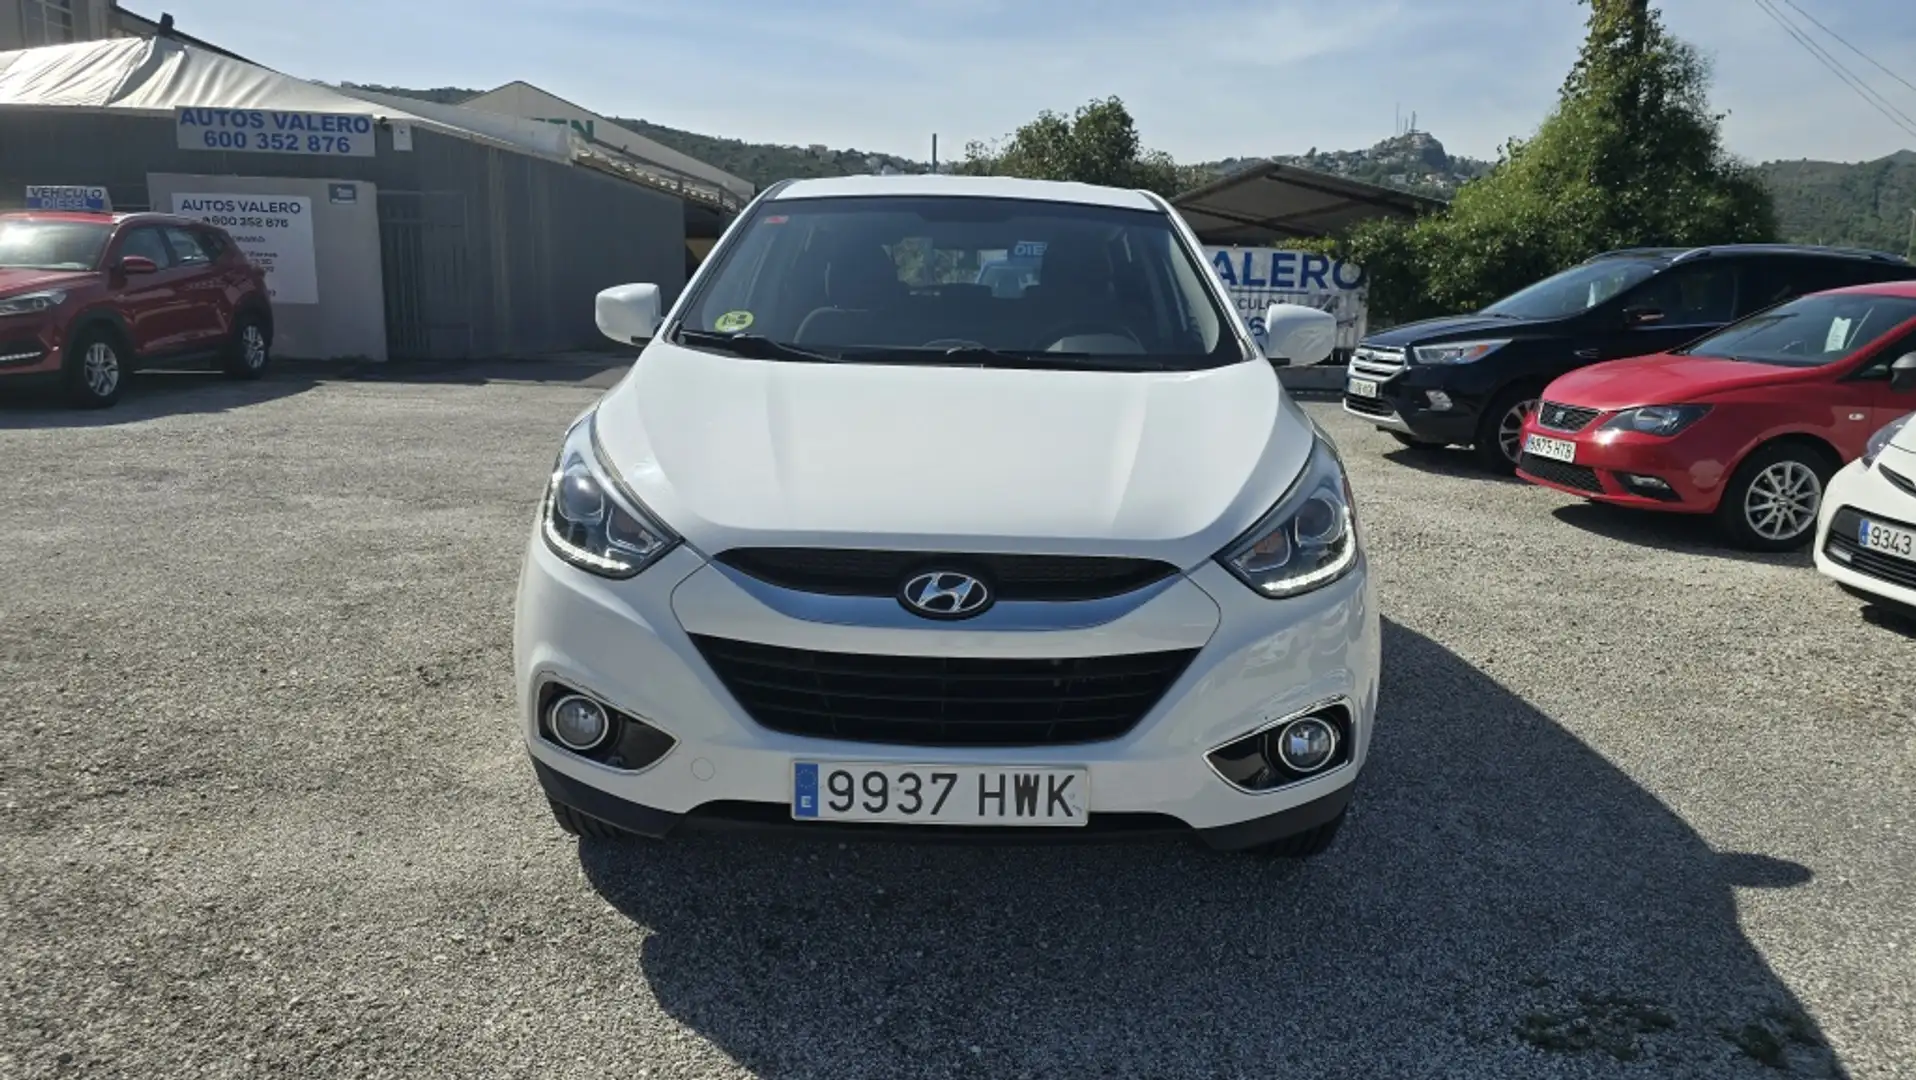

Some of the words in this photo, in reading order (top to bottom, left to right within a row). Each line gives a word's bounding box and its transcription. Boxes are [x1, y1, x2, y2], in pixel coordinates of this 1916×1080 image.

[180, 109, 265, 128] AUTOS
[273, 113, 370, 134] VALERO
[204, 130, 247, 148] 600
[256, 132, 299, 151] 352
[307, 135, 351, 153] 876
[41, 198, 87, 209] DIESEL
[181, 200, 235, 211] AUTOS
[238, 201, 301, 214] VALERO
[1014, 243, 1047, 256] DIE
[1213, 250, 1364, 290] ALERO
[1871, 526, 1912, 555] 9343
[801, 796, 812, 808] E
[827, 770, 958, 815] 9937
[978, 773, 1075, 817] HWK
